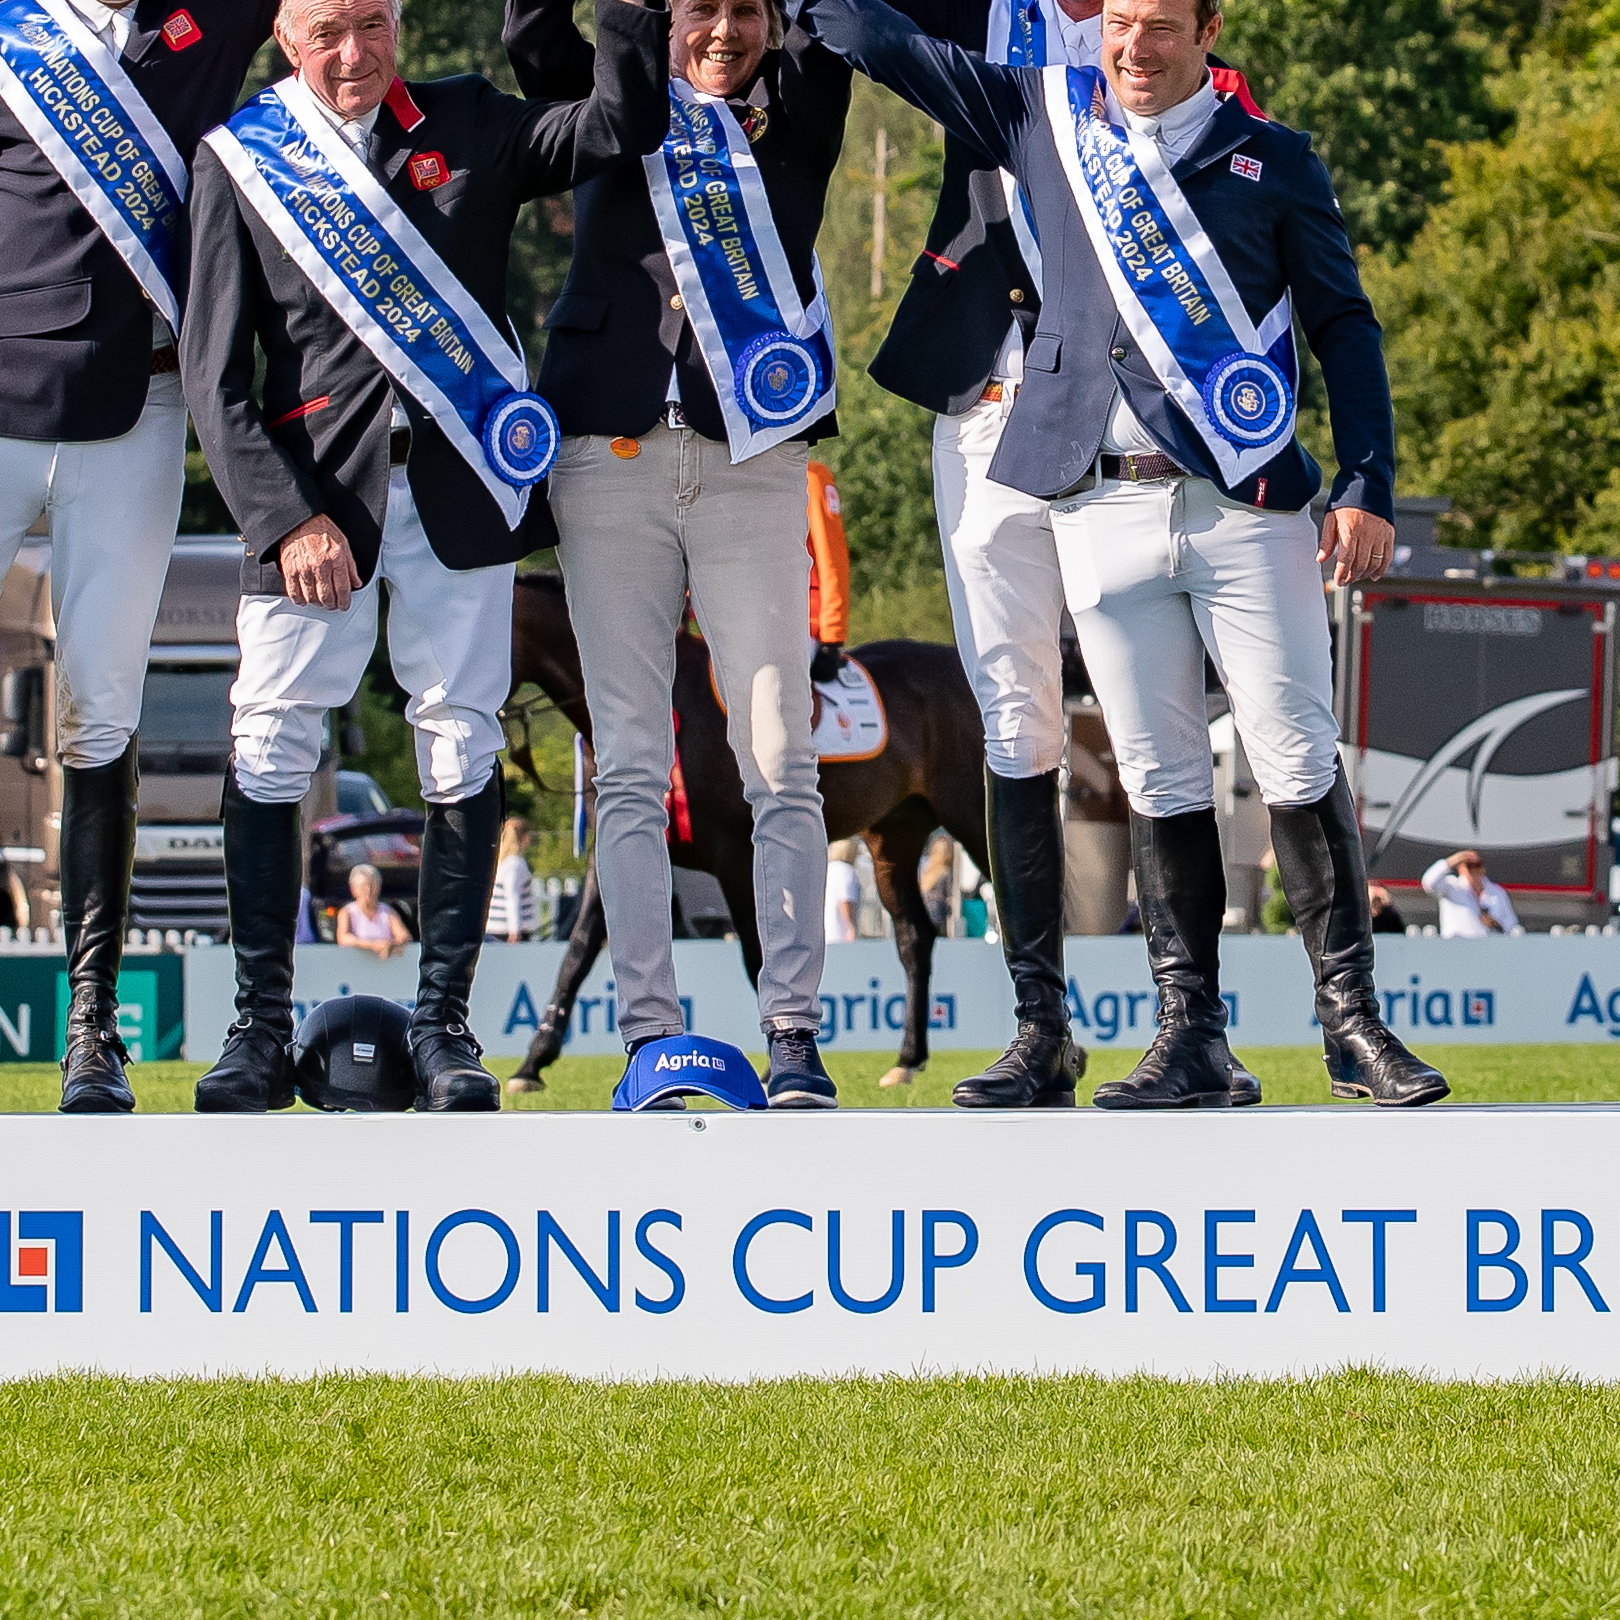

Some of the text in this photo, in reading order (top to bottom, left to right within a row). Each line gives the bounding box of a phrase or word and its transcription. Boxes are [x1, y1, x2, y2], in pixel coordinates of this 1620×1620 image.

[28, 67, 156, 230] HICKSTEAD 2024
[44, 47, 100, 111] NATIONS
[90, 108, 123, 139] CUP
[115, 137, 139, 161] OF
[132, 162, 170, 211] GREAT
[700, 159, 722, 176] OF
[683, 194, 713, 245] 2024
[705, 181, 737, 232] GREAT
[1105, 153, 1131, 186] CUP
[1118, 187, 1143, 209] OF
[1132, 211, 1174, 264] GREAT
[1161, 261, 1211, 325] BRITAIN
[286, 188, 421, 342] HICKSTEAD 2024
[721, 238, 759, 300] BRITAIN
[1114, 231, 1153, 281] 2024
[348, 225, 380, 255] CUP
[373, 254, 398, 276] OF
[390, 275, 438, 323] GREAT
[429, 318, 475, 374] BRITAIN
[654, 1049, 711, 1073] Agria
[140, 1210, 684, 1314] NATIONS
[732, 1210, 977, 1314] CUP
[1023, 1209, 1416, 1314] GREAT
